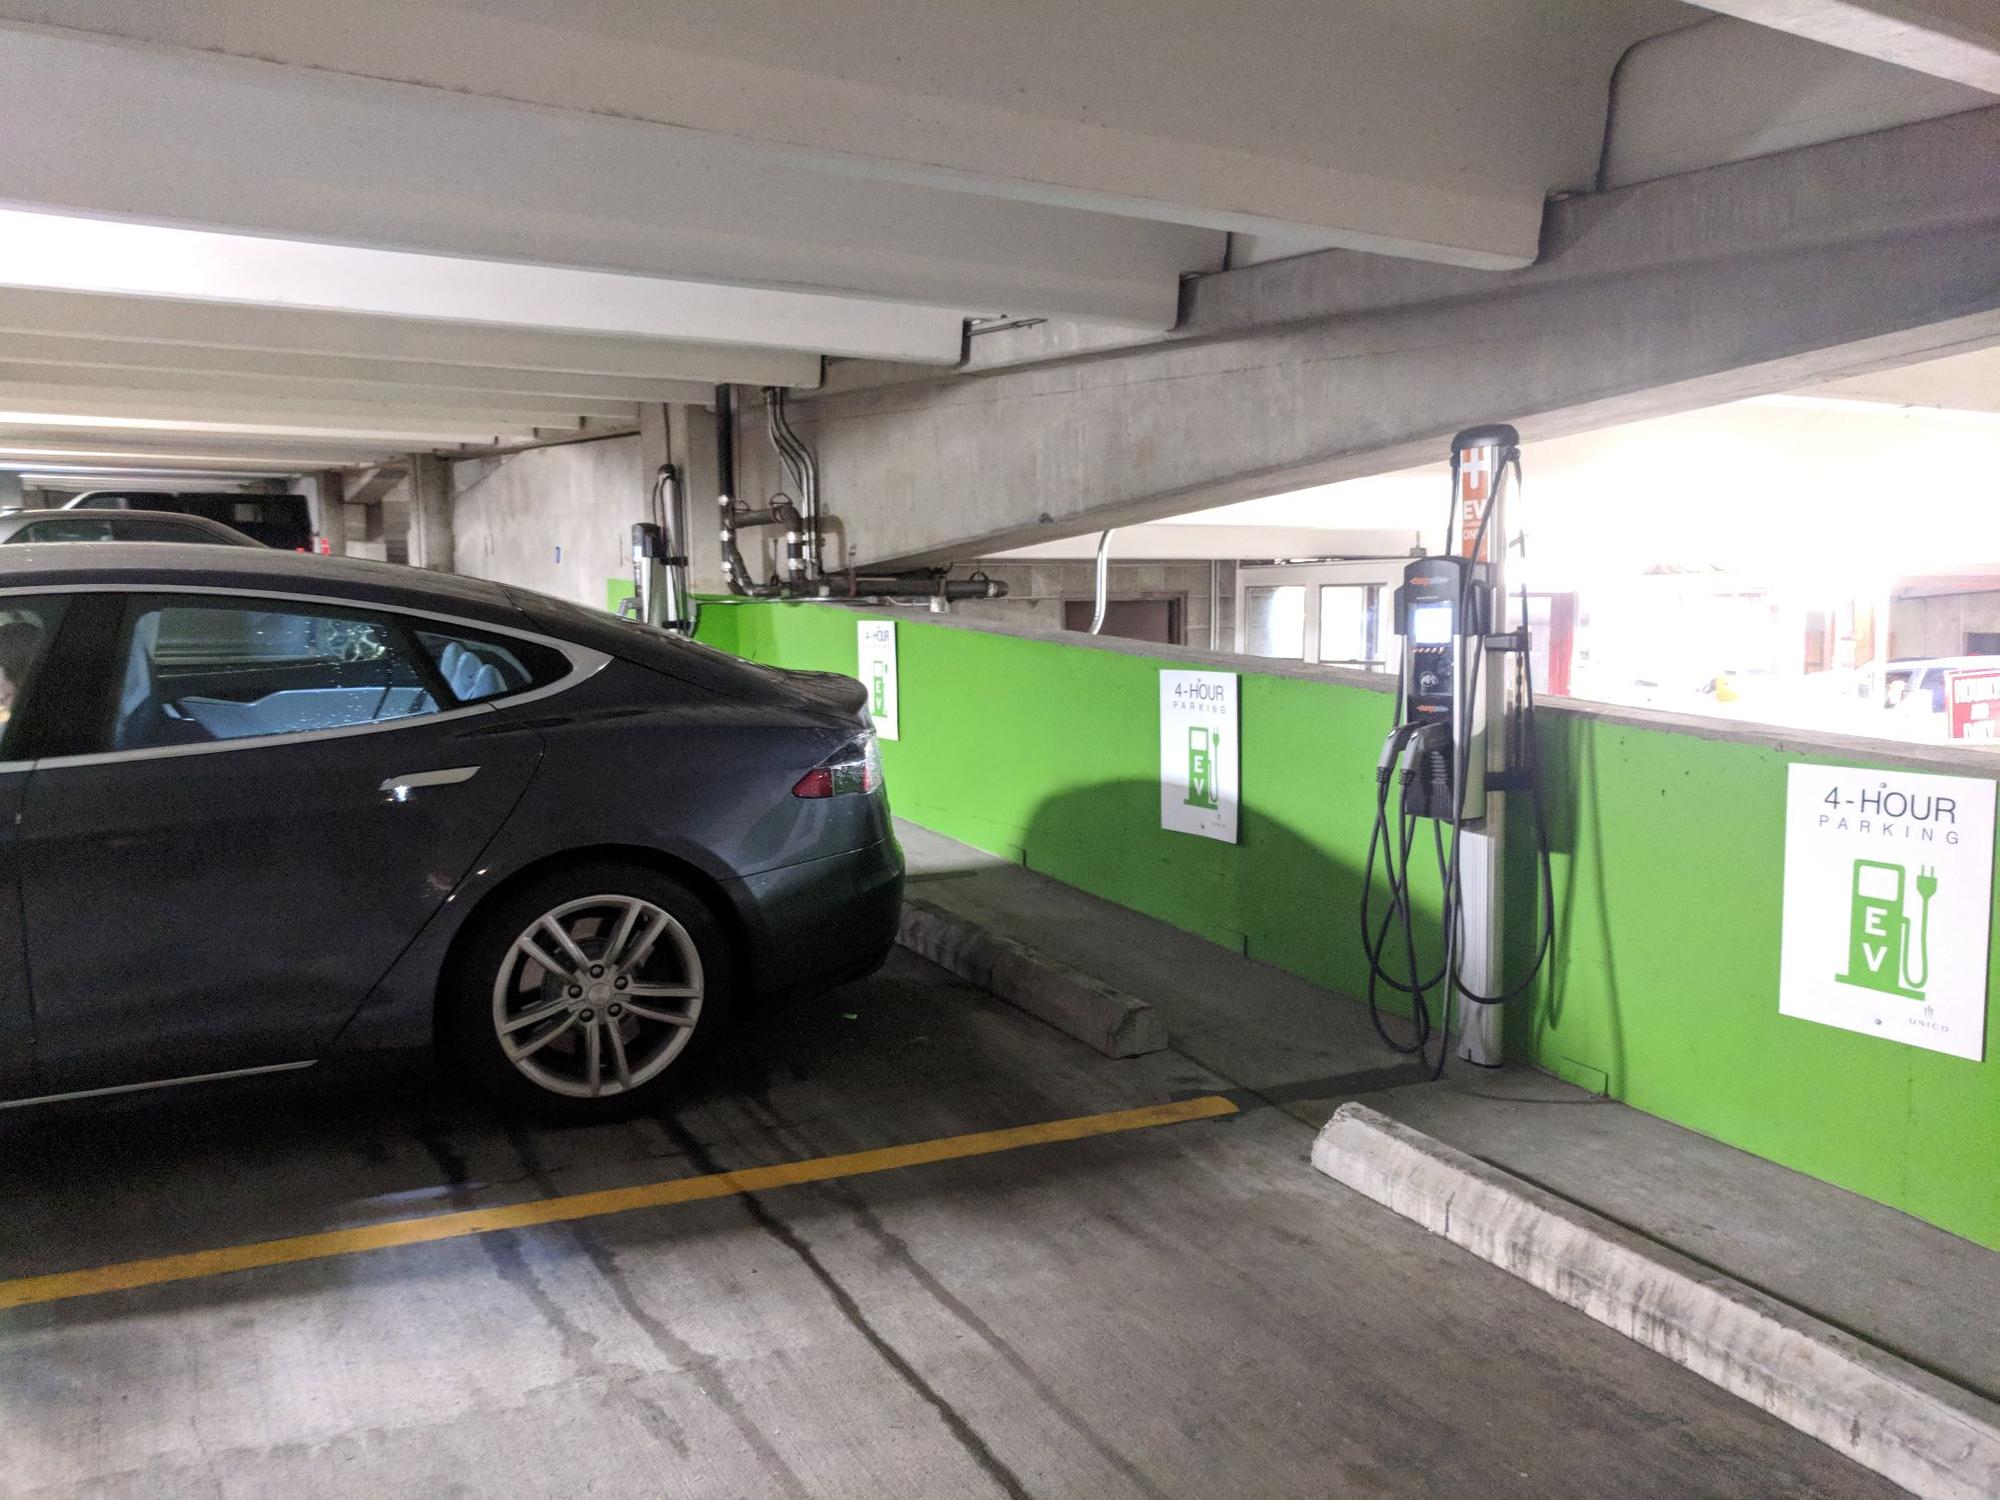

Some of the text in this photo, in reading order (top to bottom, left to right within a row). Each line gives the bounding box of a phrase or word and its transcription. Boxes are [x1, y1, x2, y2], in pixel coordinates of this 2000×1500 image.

[1463, 500, 1488, 521] EV
[1174, 682, 1224, 701] 4-HOUR
[1173, 700, 1226, 714] PARKING
[1824, 786, 1957, 823] 4-HOUR
[1819, 814, 1960, 845] PARKING
[1908, 1017, 1949, 1033] UNICO
